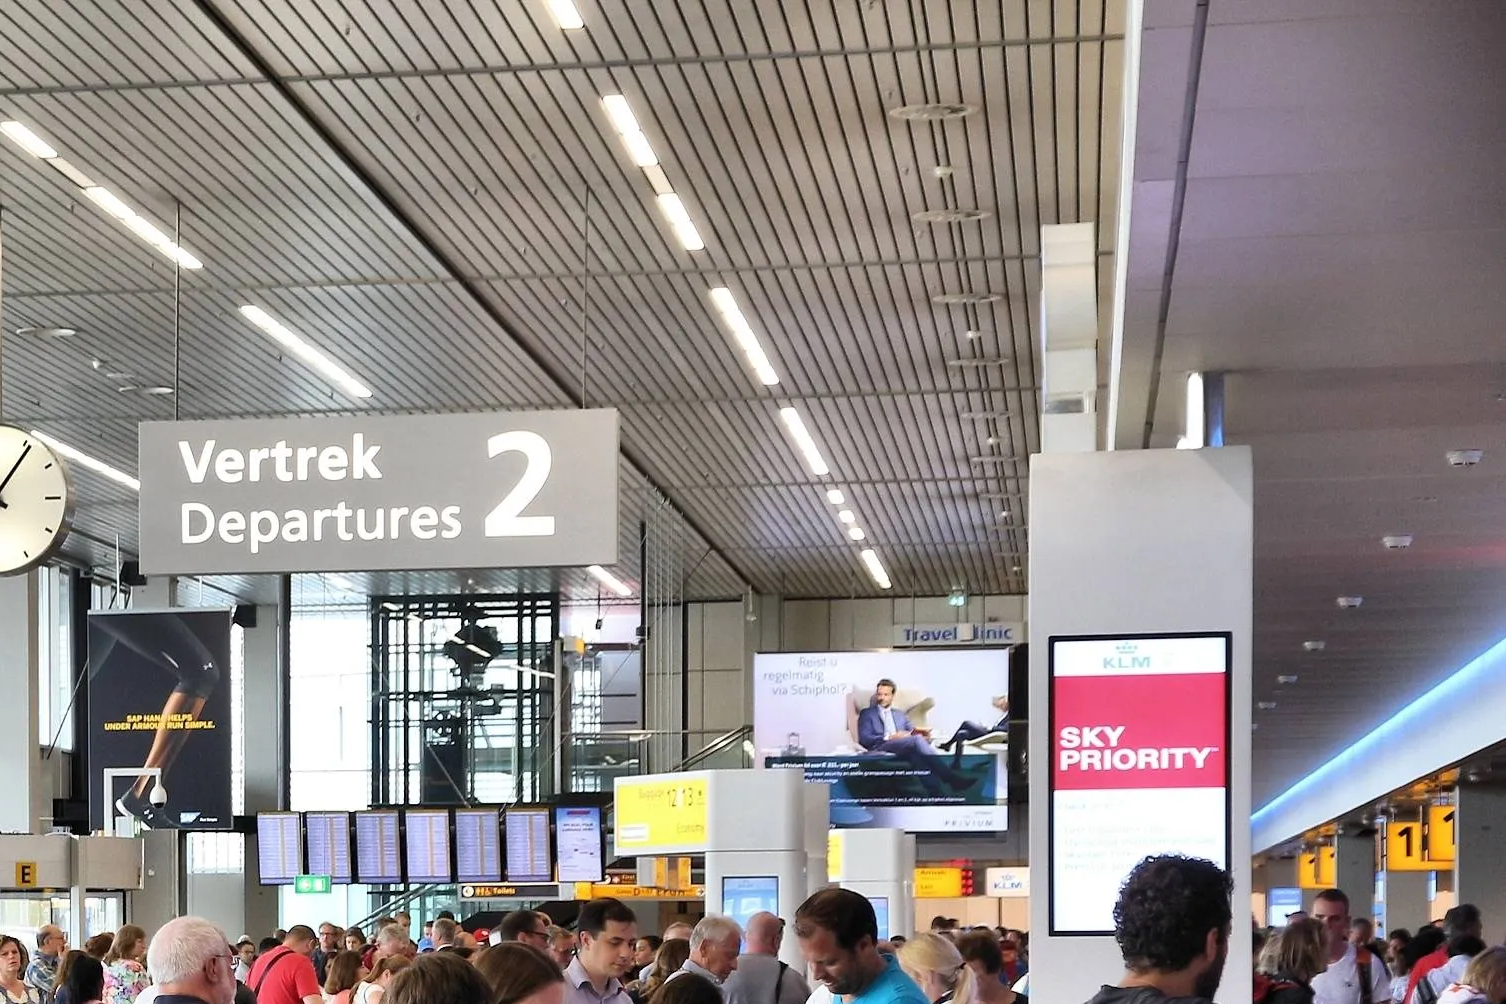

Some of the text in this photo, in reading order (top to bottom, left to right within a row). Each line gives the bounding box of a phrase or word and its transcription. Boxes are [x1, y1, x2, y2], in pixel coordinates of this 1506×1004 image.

[177, 432, 383, 484] Vertrek
[483, 429, 556, 537] 2
[180, 500, 462, 554] Departures
[903, 627, 958, 641] Travel
[798, 656, 827, 668] Reist
[1102, 656, 1151, 669] KLM
[772, 685, 788, 695] via
[104, 722, 131, 731] UNDER
[1059, 725, 1126, 749] SKY
[1059, 747, 1212, 772] PRIORITY
[21, 865, 31, 884] E
